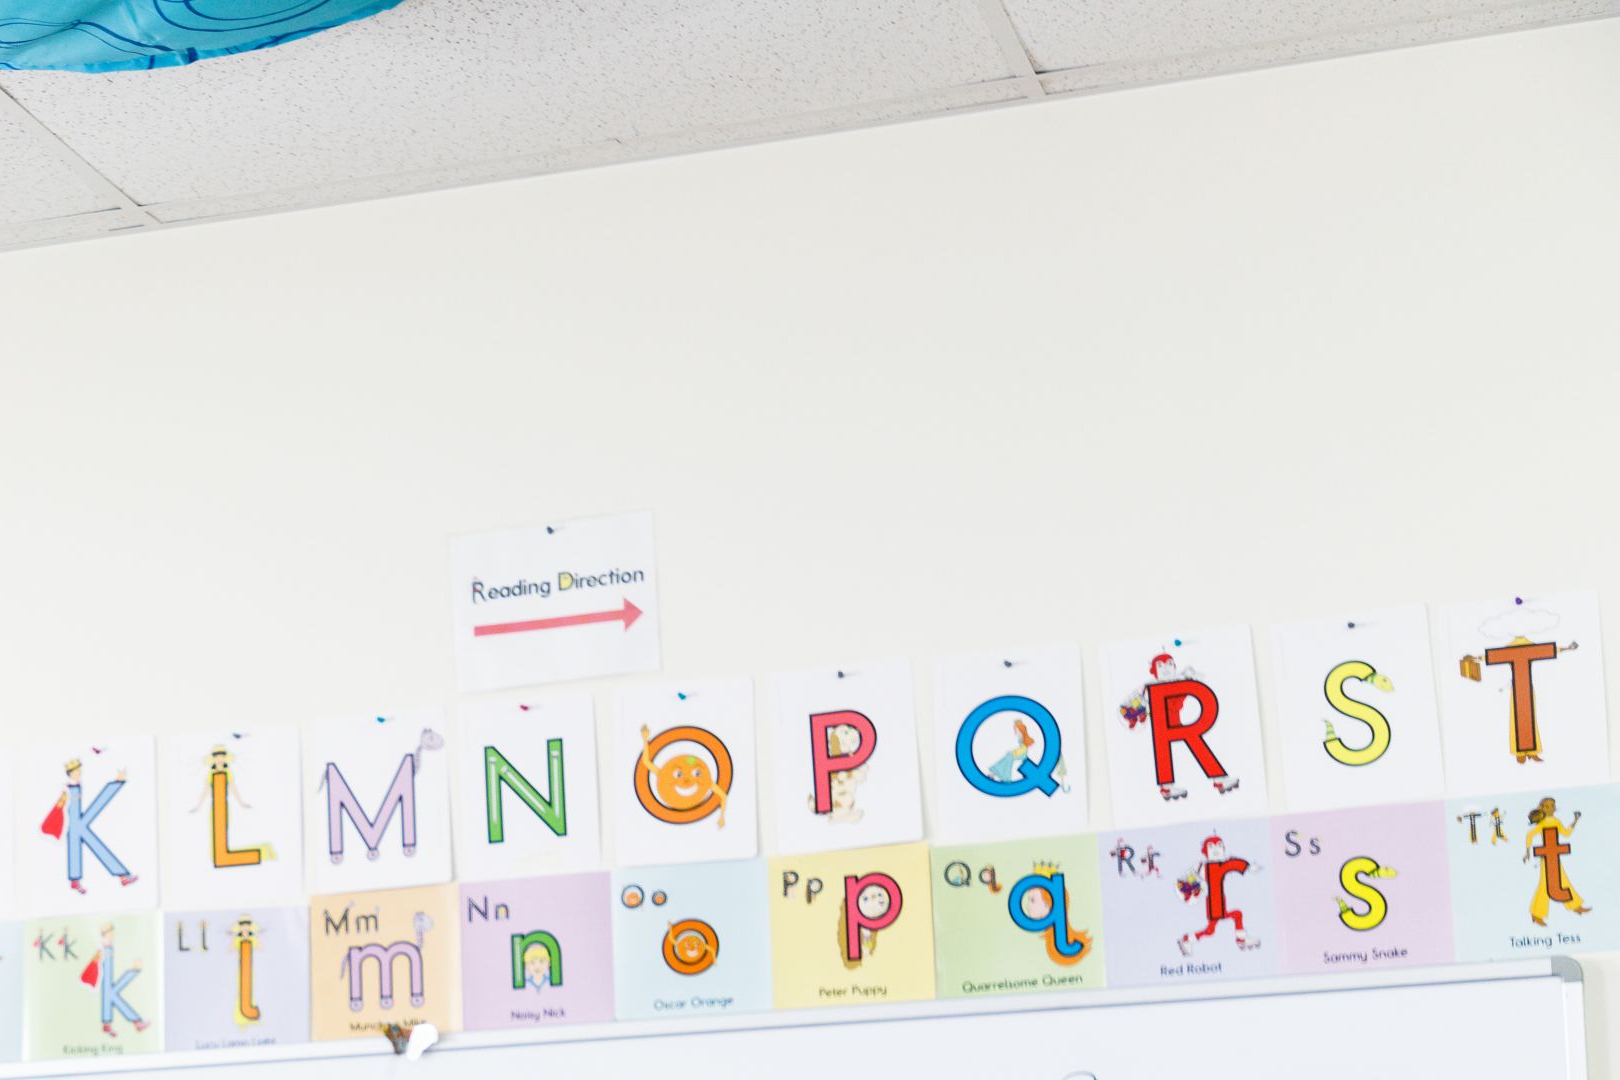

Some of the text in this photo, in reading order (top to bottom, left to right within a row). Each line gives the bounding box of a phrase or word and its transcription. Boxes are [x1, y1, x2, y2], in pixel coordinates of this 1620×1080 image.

[472, 568, 645, 604] Reading Direction
[1146, 679, 1228, 786] R
[1323, 660, 1391, 767] S
[1485, 642, 1557, 752] T
[633, 725, 733, 825] O
[809, 709, 877, 815] P
[955, 694, 1062, 797] Q
[211, 771, 261, 868] L
[326, 753, 416, 856] M
[484, 738, 567, 844] N
[67, 779, 131, 881] K
[1533, 827, 1573, 902] t
[844, 872, 903, 961] p
[1008, 872, 1084, 957] q
[1206, 857, 1250, 921] r
[1339, 856, 1388, 932] s
[348, 941, 424, 1002] m
[511, 930, 563, 989] n
[662, 918, 719, 976] o
[1160, 962, 1222, 976] Red Robot
[1324, 947, 1408, 966] Sammy Snake
[1509, 933, 1582, 950] Talking Tess
[101, 945, 143, 1024] k
[653, 995, 733, 1011] Oscar Orange
[819, 985, 887, 998] Peter Puppy
[962, 973, 1083, 993] Quarrelsome Queen
